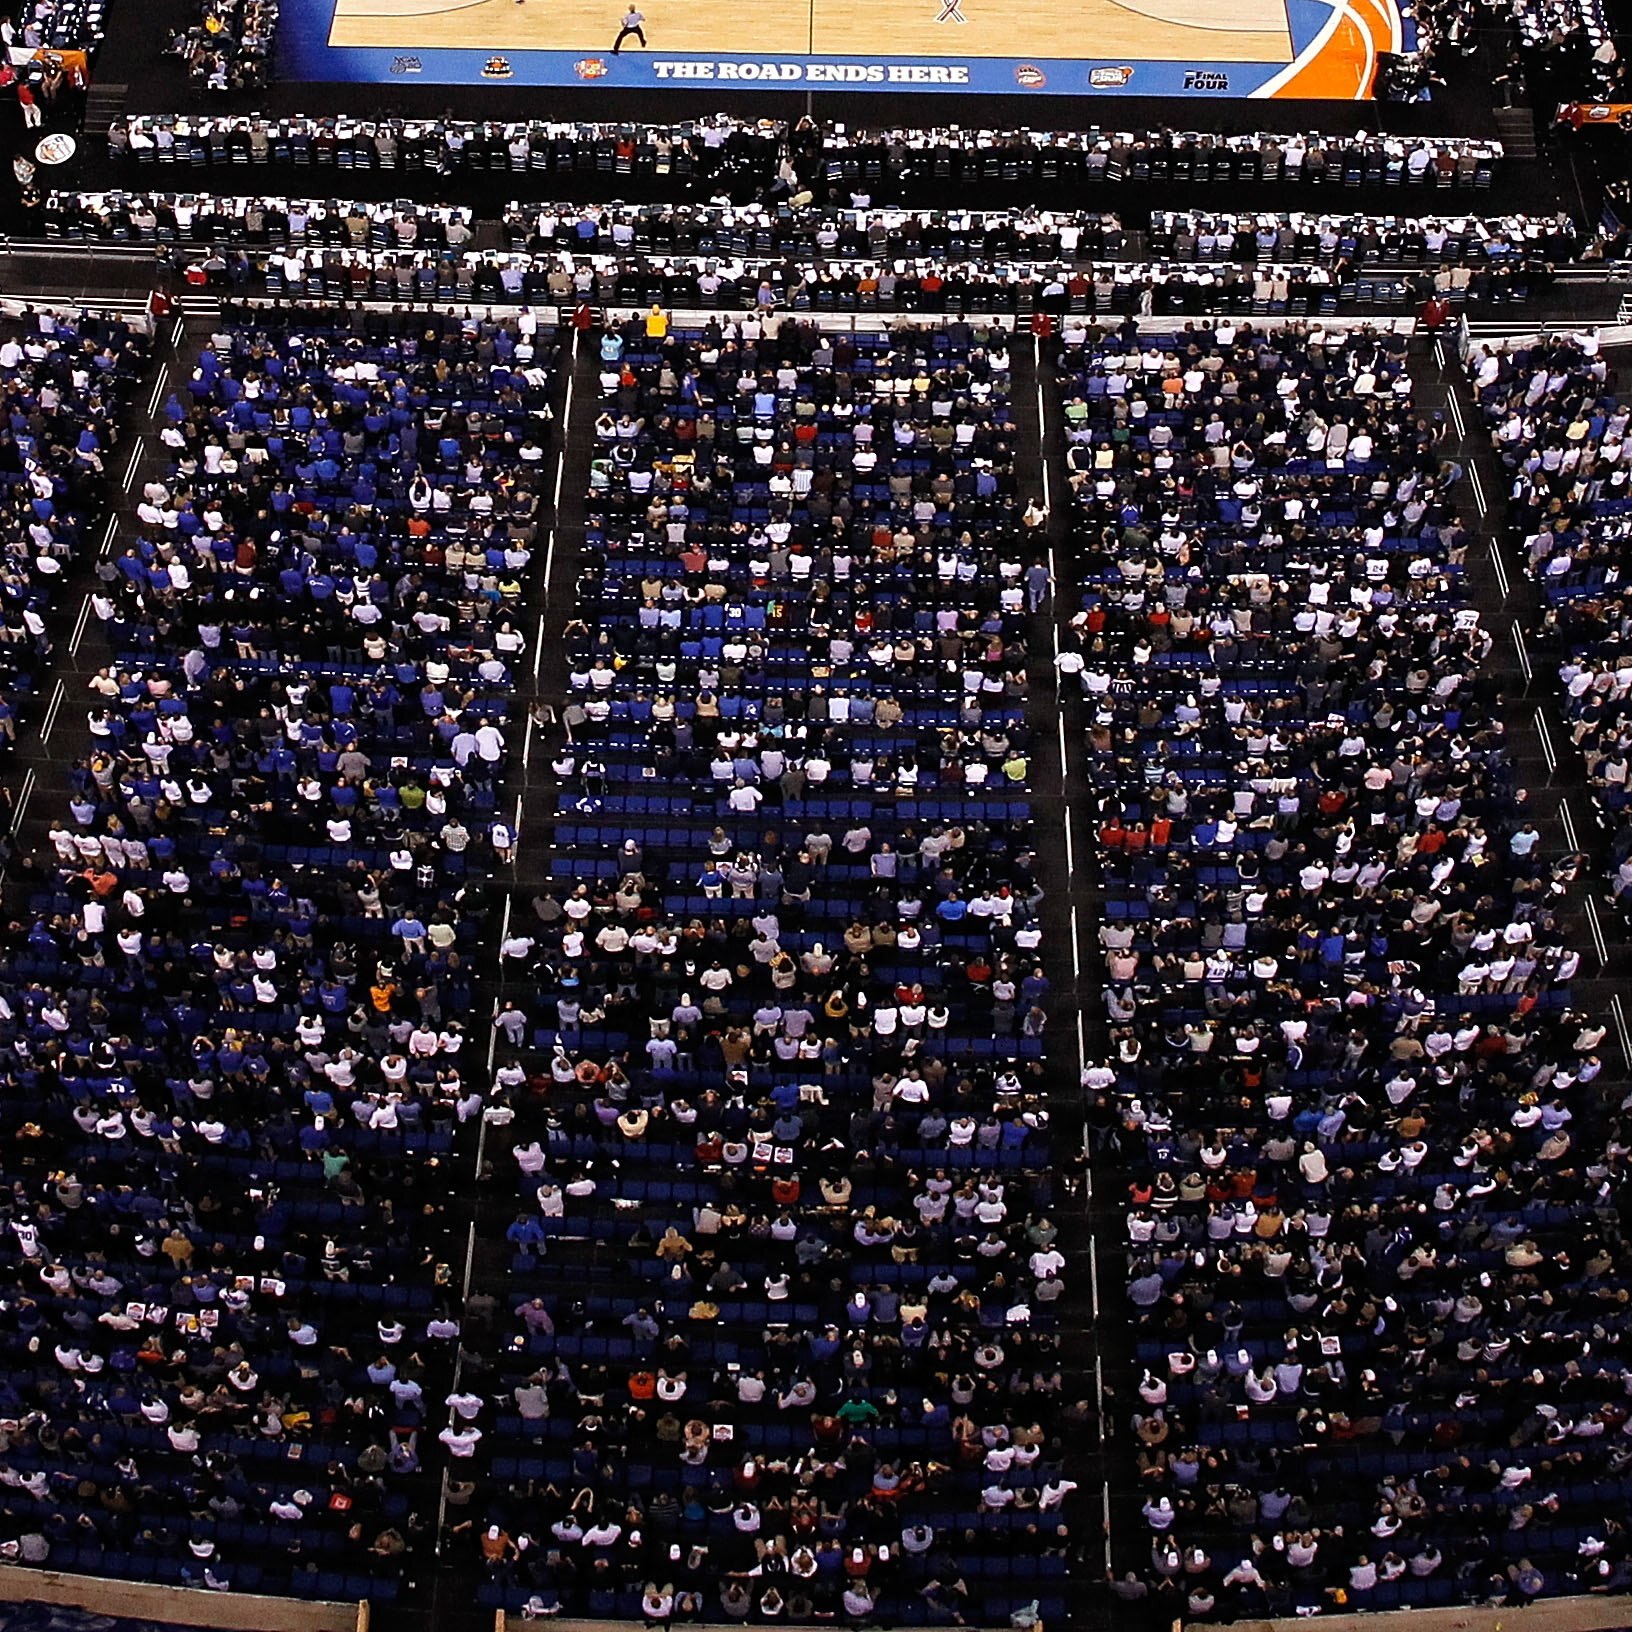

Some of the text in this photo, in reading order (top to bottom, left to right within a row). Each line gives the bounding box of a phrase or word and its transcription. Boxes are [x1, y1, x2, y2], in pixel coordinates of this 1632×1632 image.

[653, 61, 969, 84] THE ROAD ENDS HERE
[1196, 71, 1228, 81] FINAL
[1183, 79, 1228, 91] FOUR
